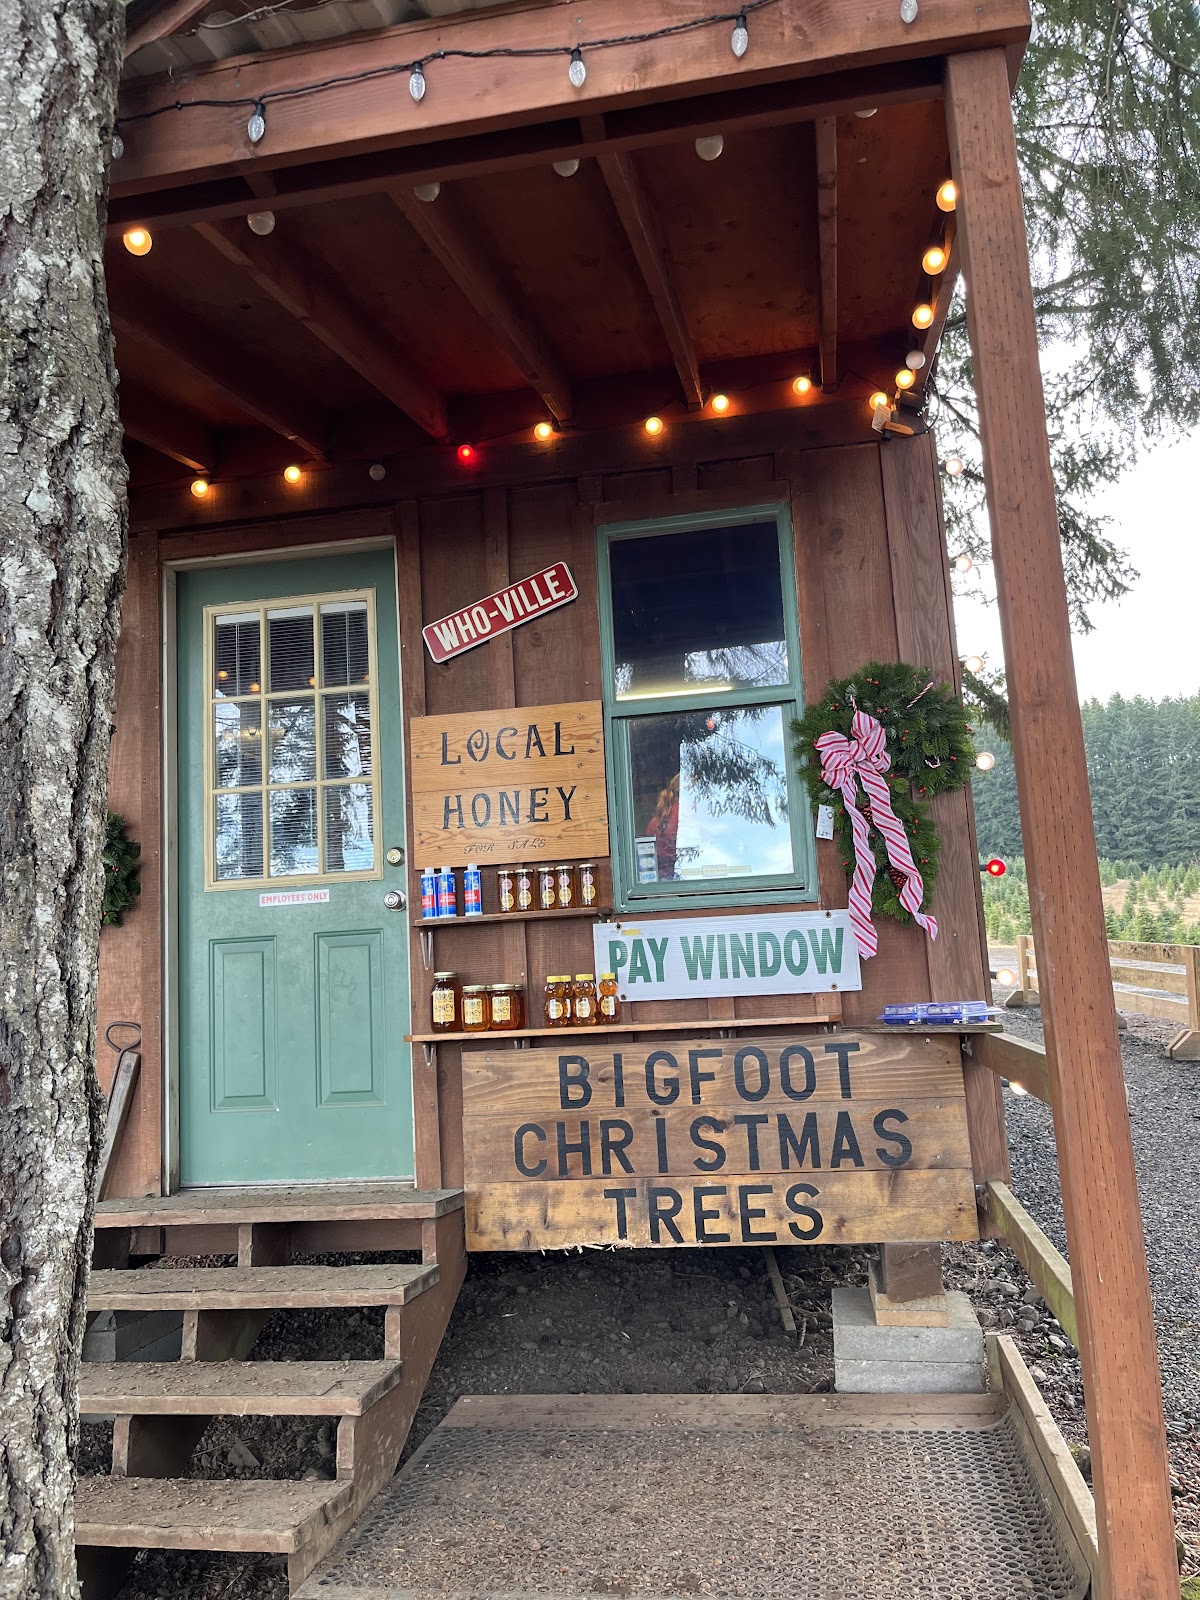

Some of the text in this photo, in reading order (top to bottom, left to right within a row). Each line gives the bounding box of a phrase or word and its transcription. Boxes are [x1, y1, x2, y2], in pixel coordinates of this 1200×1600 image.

[432, 569, 566, 652] WHO-VILLE
[440, 721, 575, 765] LOCAL
[442, 785, 577, 830] HONEY
[463, 838, 546, 854] FOR SALE
[261, 891, 328, 904] EMPLOYEES ONLY
[640, 873, 656, 881] VISA
[608, 927, 844, 984] PAY WINDOW
[558, 1042, 861, 1110] BIGFOOT
[513, 1108, 914, 1178] CHRISTMAS
[603, 1183, 825, 1243] TREES
